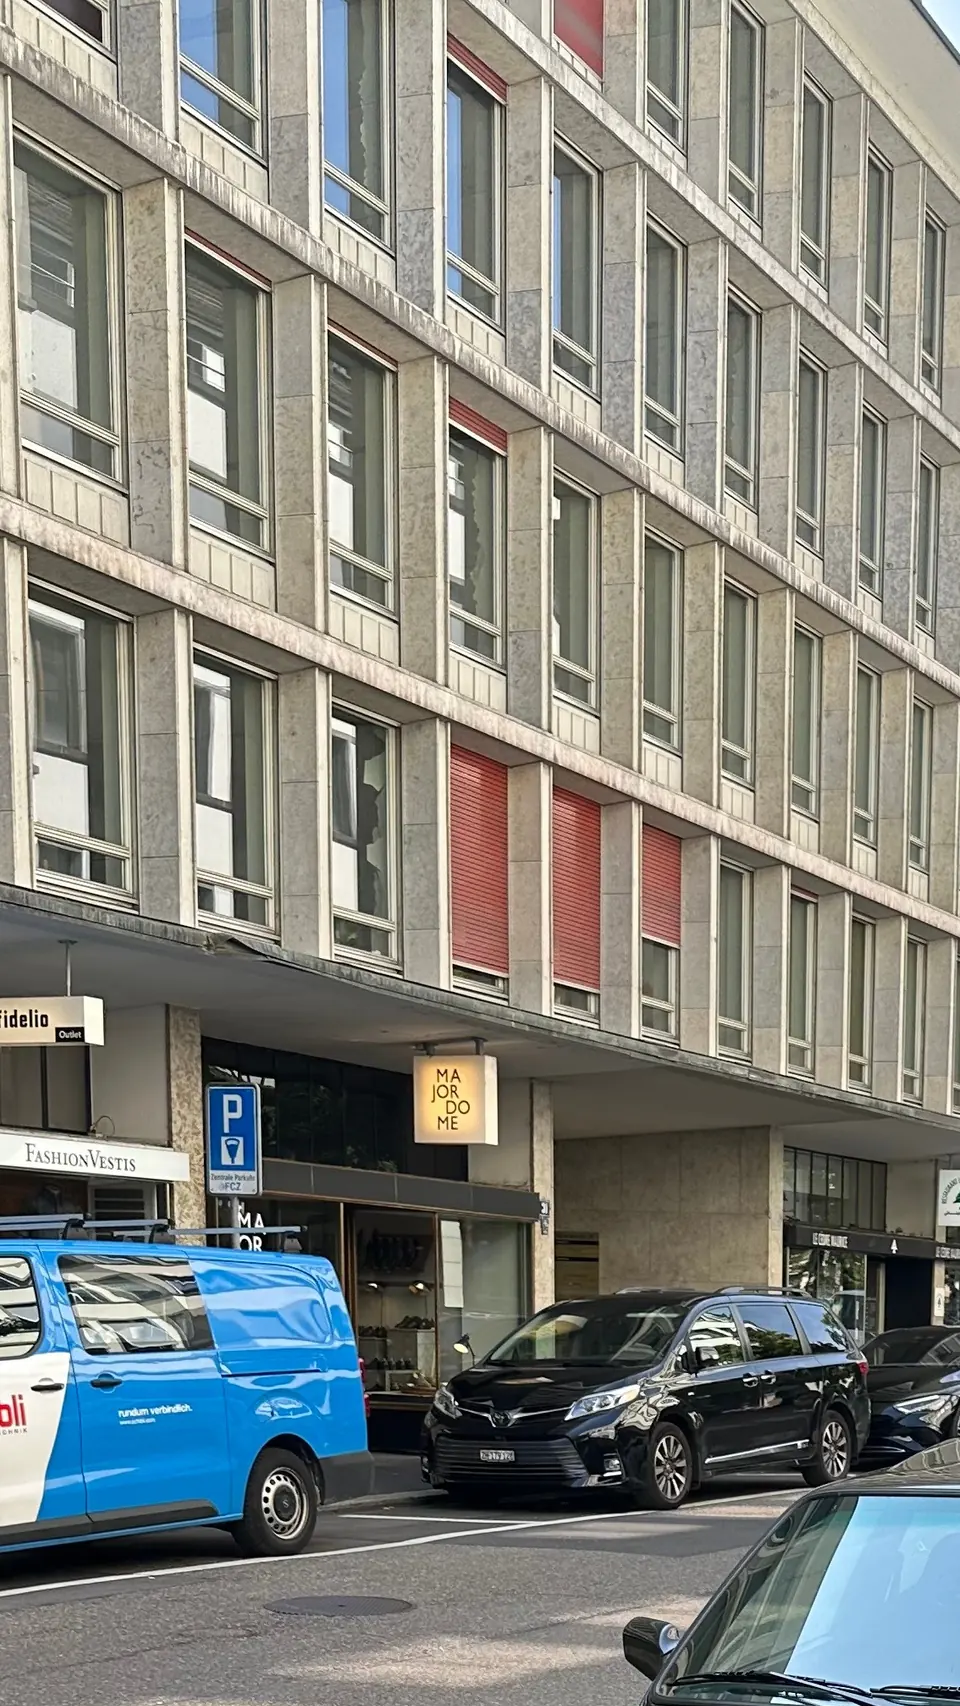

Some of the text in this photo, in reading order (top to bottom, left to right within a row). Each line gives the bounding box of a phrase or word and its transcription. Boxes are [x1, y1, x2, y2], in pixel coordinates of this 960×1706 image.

[59, 1030, 81, 1039] Outlet
[436, 1069, 461, 1083] MA
[431, 1084, 459, 1103] JOR
[223, 1094, 242, 1133] P
[446, 1100, 470, 1114] DO
[438, 1116, 458, 1130] ME
[118, 1407, 149, 1417] rundum
[0, 1428, 28, 1436] CHNIK
